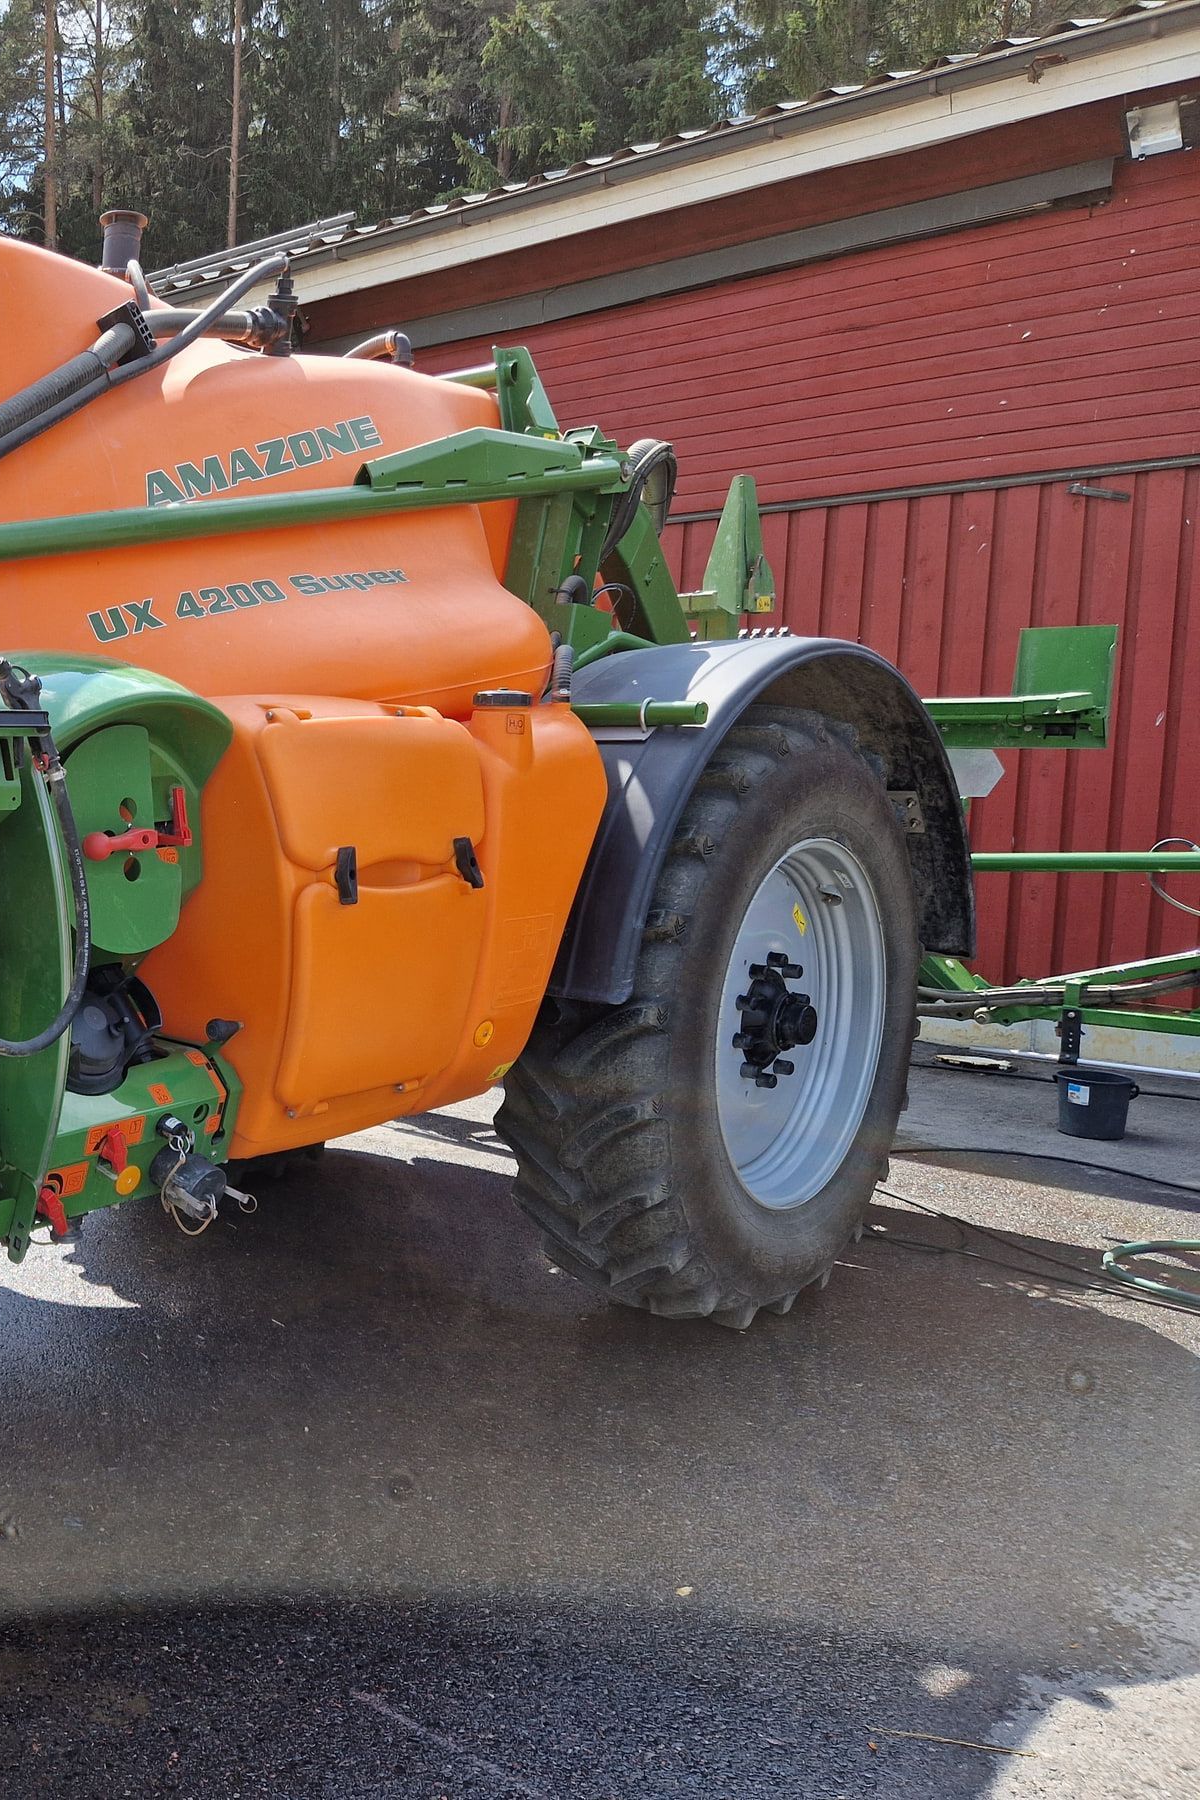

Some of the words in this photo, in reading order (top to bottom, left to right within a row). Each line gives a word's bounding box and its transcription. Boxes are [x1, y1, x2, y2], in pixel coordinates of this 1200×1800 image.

[145, 416, 383, 507] AMAZONE
[87, 599, 166, 643] UX
[175, 578, 287, 619] 4200
[288, 568, 410, 596] Super
